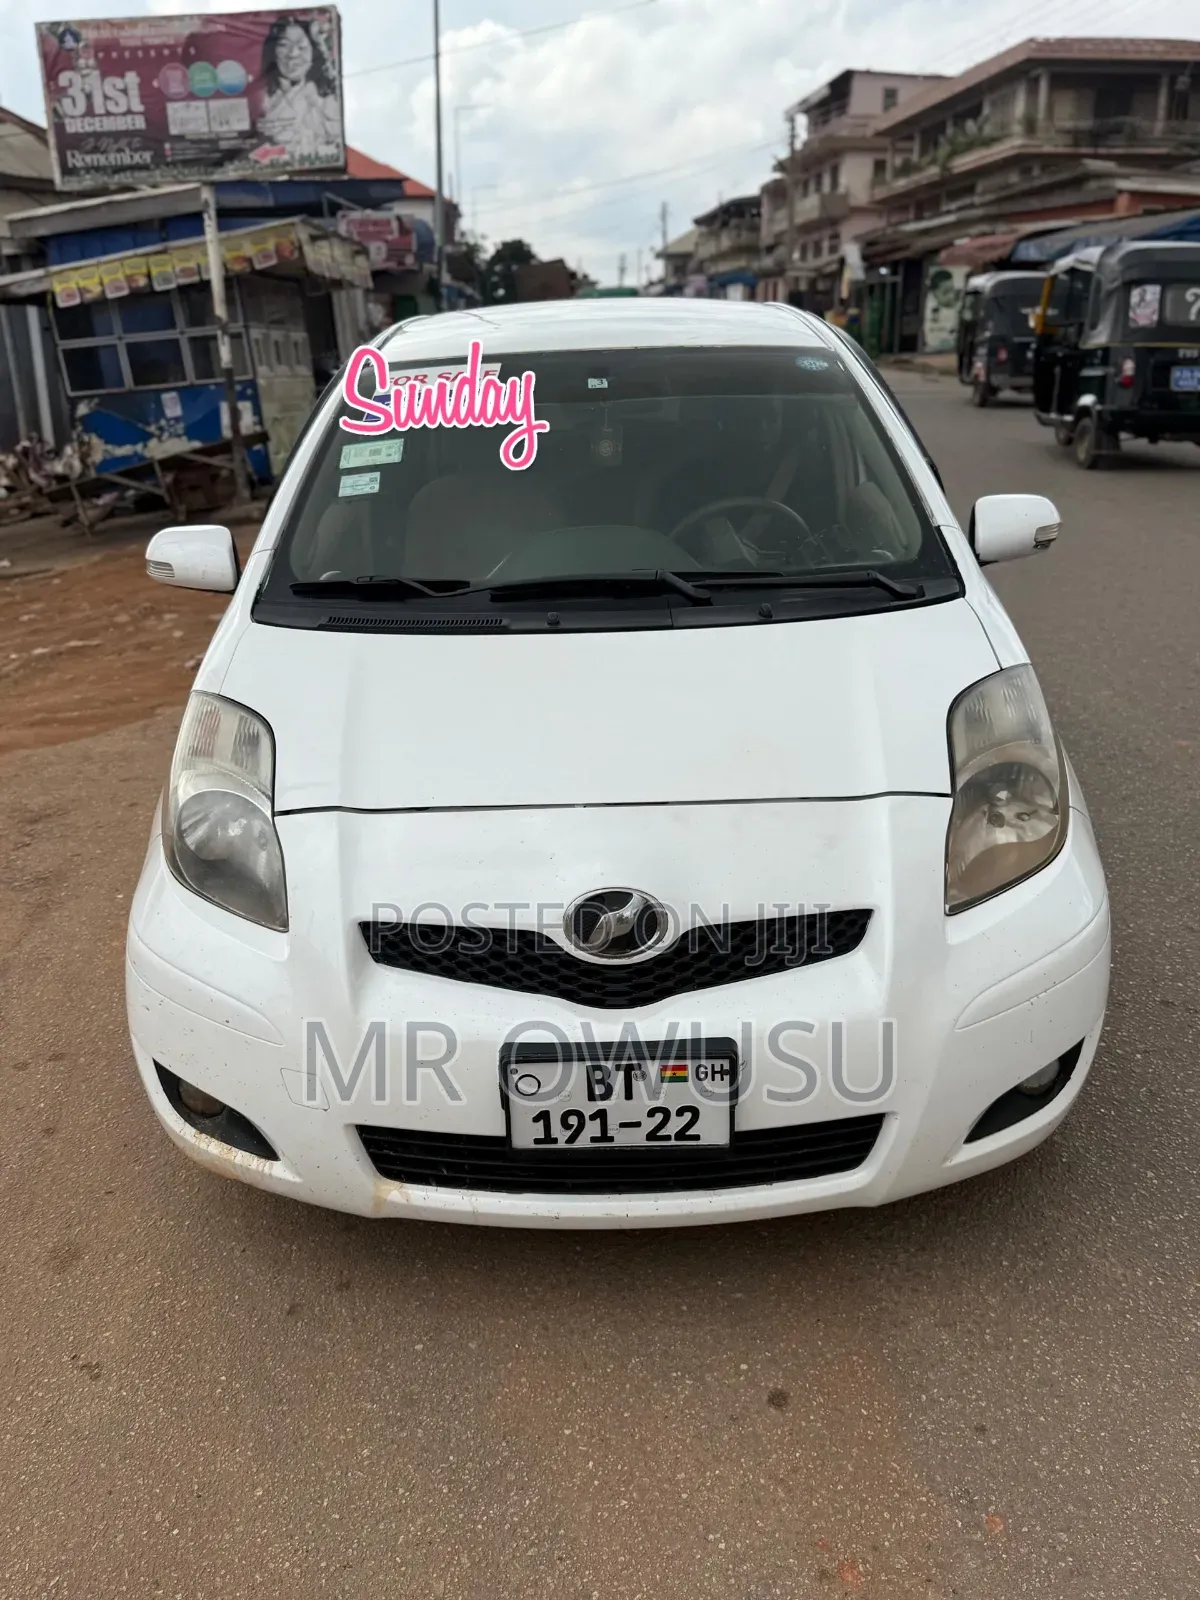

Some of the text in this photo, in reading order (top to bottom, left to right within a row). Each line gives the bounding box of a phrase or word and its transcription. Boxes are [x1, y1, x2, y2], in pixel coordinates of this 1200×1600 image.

[58, 70, 145, 116] 31st
[586, 1063, 642, 1101] BT
[695, 1064, 725, 1081] GH
[532, 1105, 700, 1144] 191-22
